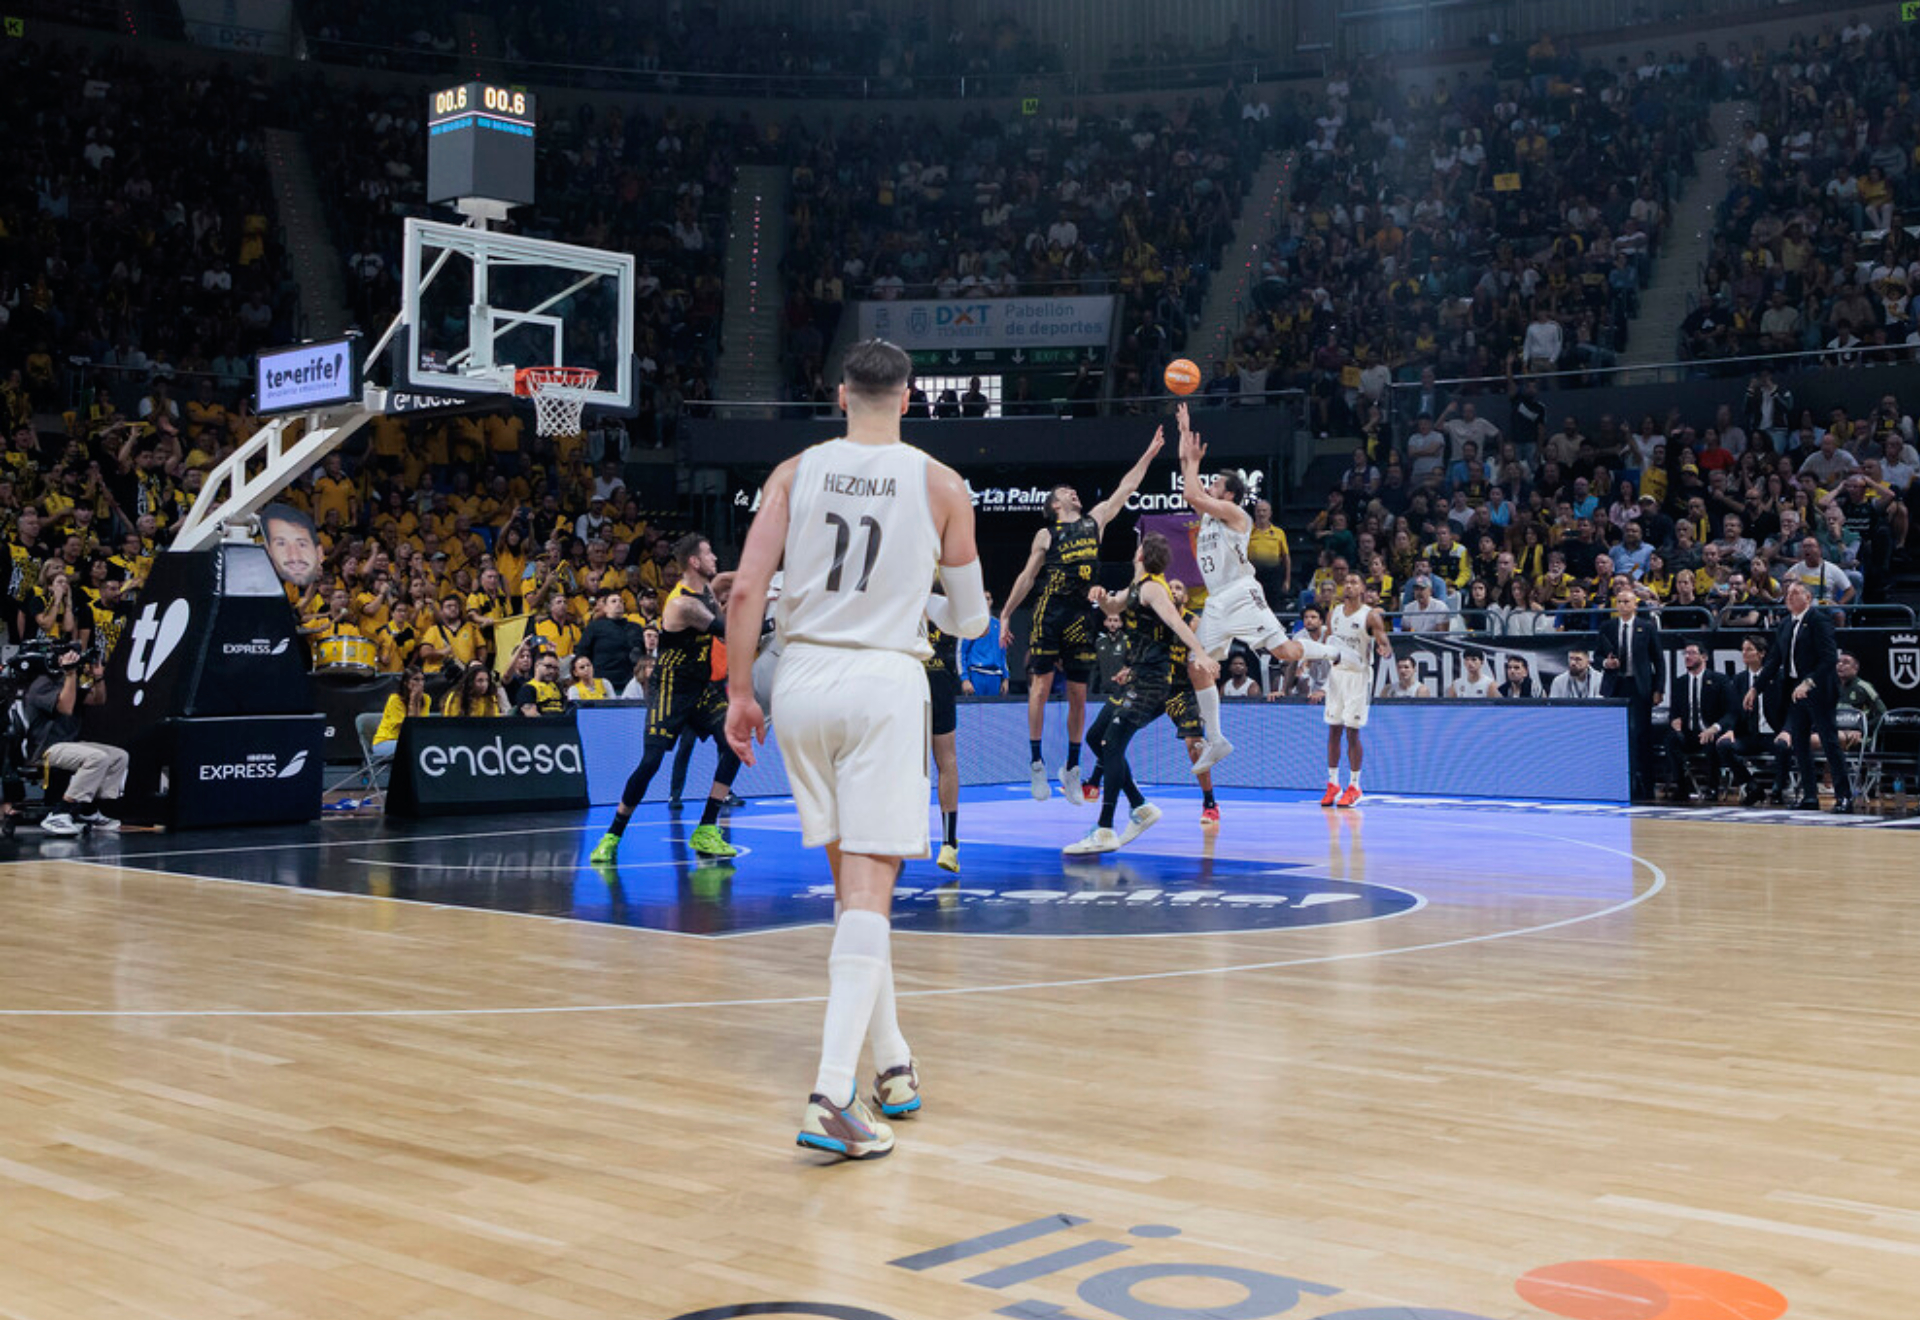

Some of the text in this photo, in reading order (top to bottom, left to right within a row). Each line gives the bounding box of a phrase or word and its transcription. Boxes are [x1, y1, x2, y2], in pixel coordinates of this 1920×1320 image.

[9, 20, 18, 33] K
[435, 87, 467, 115] 00.6
[484, 86, 526, 115] 00.6
[1025, 100, 1037, 111] M
[936, 305, 992, 324] DXT
[1005, 303, 1074, 318] Pabellón
[1006, 320, 1103, 337] de deportes
[266, 353, 342, 389] tenerife!
[823, 472, 897, 497] HEZONJA
[983, 487, 1052, 504] La Palm
[825, 511, 883, 593] 11
[1201, 556, 1215, 574] 23
[223, 644, 271, 654] EXPRESS
[419, 736, 582, 777] endesa
[199, 762, 277, 780] EXPRESS
